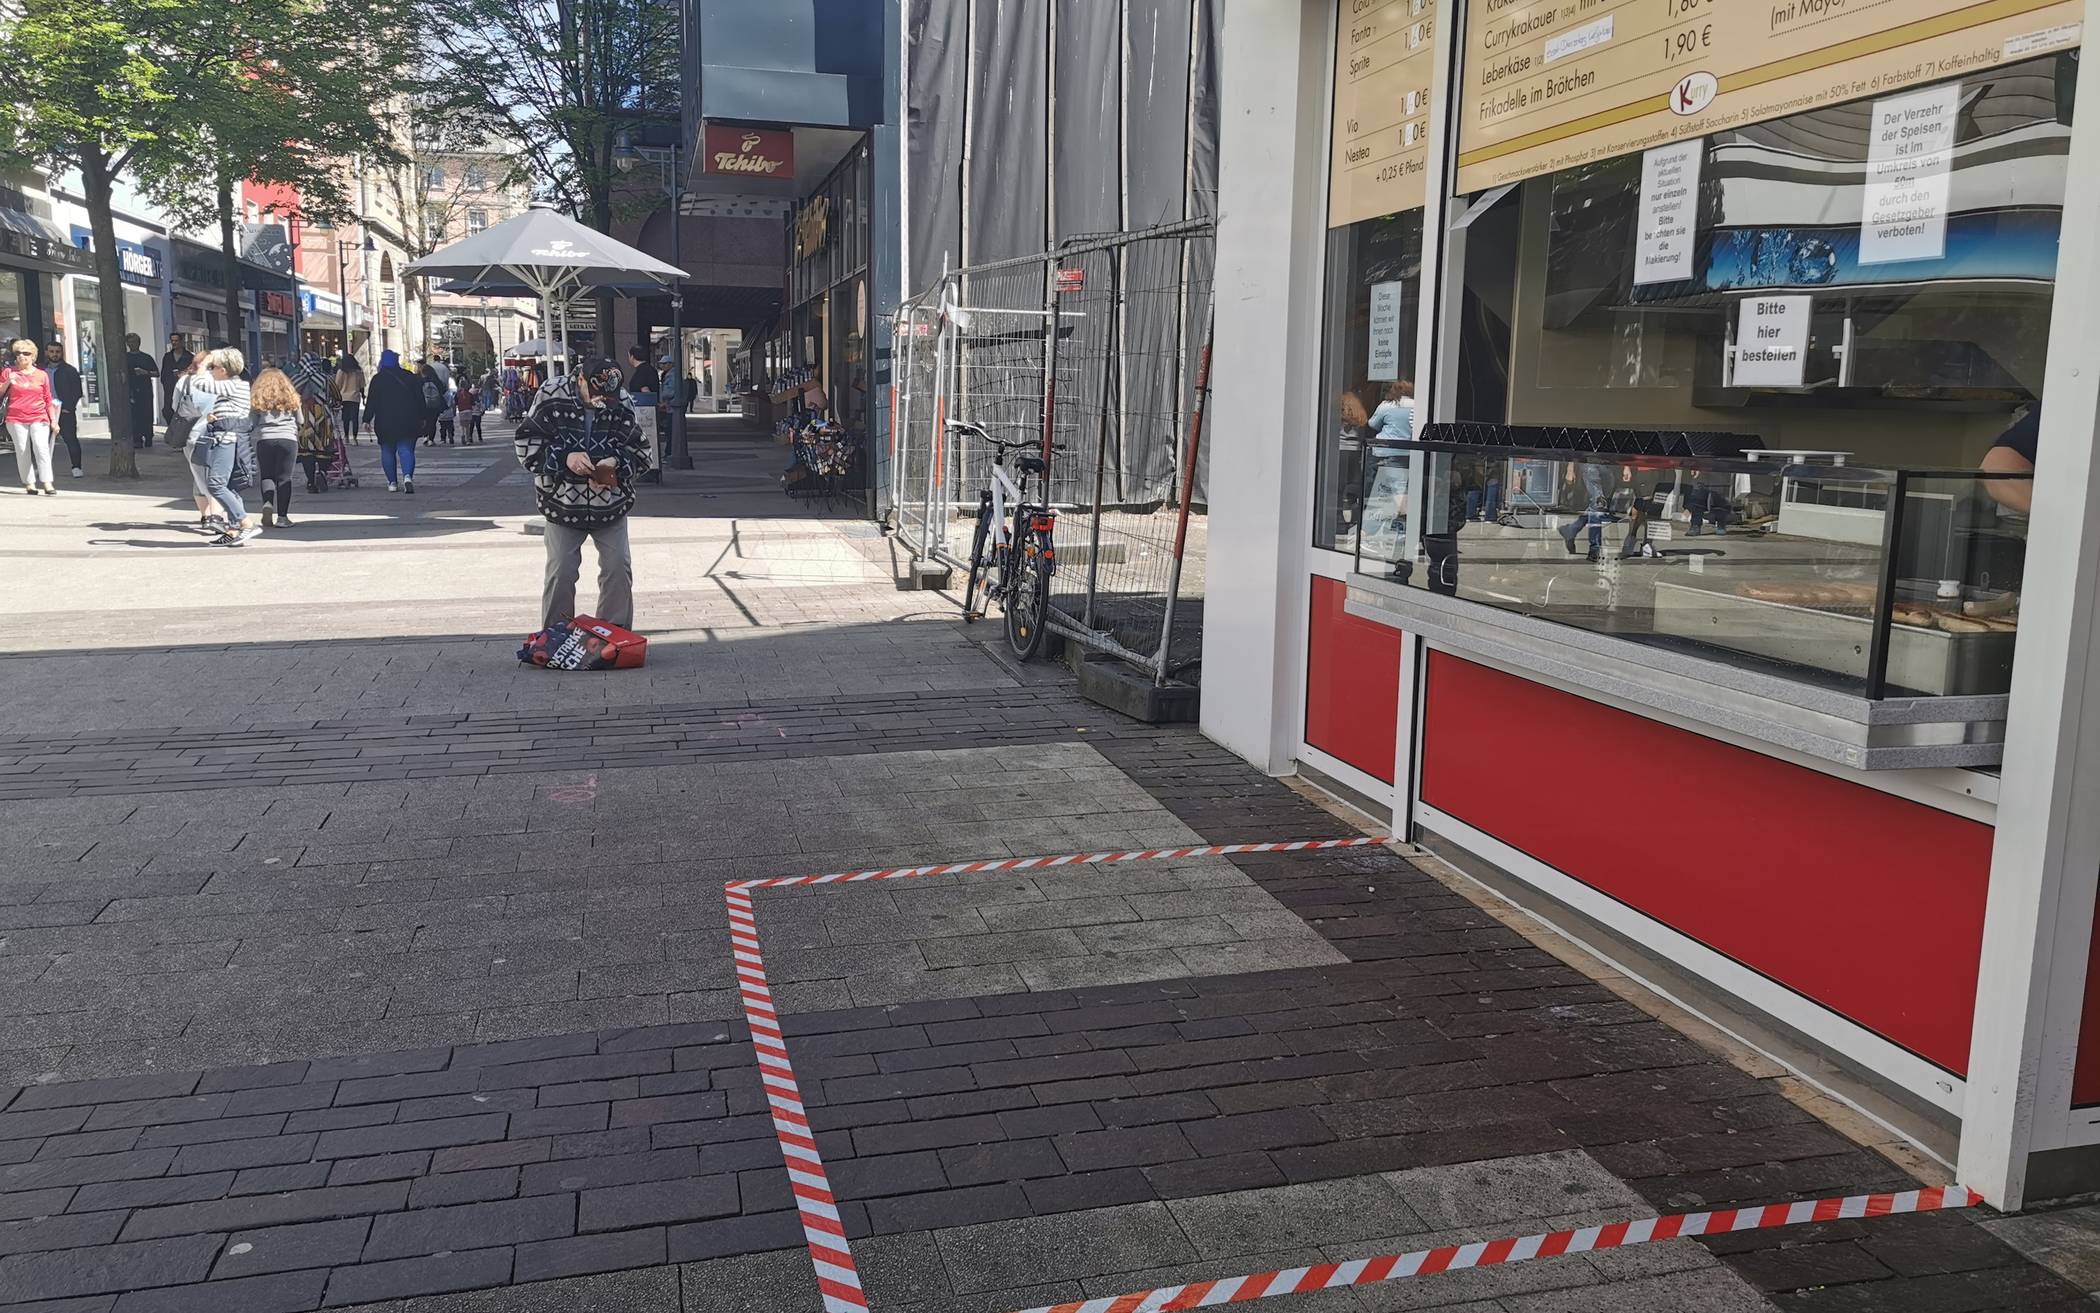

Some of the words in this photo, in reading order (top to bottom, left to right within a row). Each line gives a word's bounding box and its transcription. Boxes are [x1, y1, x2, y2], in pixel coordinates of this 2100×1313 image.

[1770, 3, 1796, 31] (mit
[1351, 26, 1371, 46] Fanta
[1484, 8, 1557, 49] Currykrakauer
[1482, 56, 1531, 86] Leberkäse
[1665, 30, 1696, 61] 1,90
[1702, 24, 1712, 46] €
[1349, 55, 1371, 79] Sprite
[1480, 88, 1527, 120] Frikadelle
[1530, 86, 1543, 104] im
[1546, 68, 1595, 99] Brötchen
[1597, 145, 1606, 156] mit
[1706, 114, 1739, 129] Saccharin
[1741, 107, 1749, 120] 5)
[1750, 95, 1813, 119] Salatmayonnaise
[1815, 91, 1828, 102] mit
[1829, 83, 1849, 99] 50%
[1851, 80, 1867, 94] Fett
[1871, 76, 1880, 89] 6)
[1883, 64, 1922, 86] Farbstoff
[1925, 59, 1936, 76] 7)
[1938, 48, 2000, 73] Koffeinhaltig
[1883, 113, 1902, 126] Der
[1904, 104, 1943, 121] Verzehr
[1346, 119, 1359, 135] Vio
[1882, 130, 1898, 142] der
[1901, 122, 1942, 141] Speisen
[1345, 146, 1370, 165] Nestea
[1896, 144, 1908, 156] ist
[1910, 142, 1923, 153] im
[714, 152, 784, 173] Tchibo
[1382, 164, 1398, 183] 0,25
[1399, 164, 1405, 177] €
[1405, 156, 1425, 175] Pfand
[1877, 159, 1917, 175] Umkreis
[1920, 157, 1940, 168] von
[1651, 192, 1662, 202] nur
[1663, 187, 1687, 200] einzeln
[1879, 193, 1908, 207] durch
[1910, 189, 1930, 201] den
[1658, 216, 1674, 226] Bitte
[1871, 207, 1935, 224] Gesetzgeber
[1676, 226, 1686, 236] sie
[1877, 222, 1925, 239] verboten!
[1659, 241, 1669, 251] die
[1757, 302, 1786, 316] Bitte
[1757, 325, 1781, 338] hier
